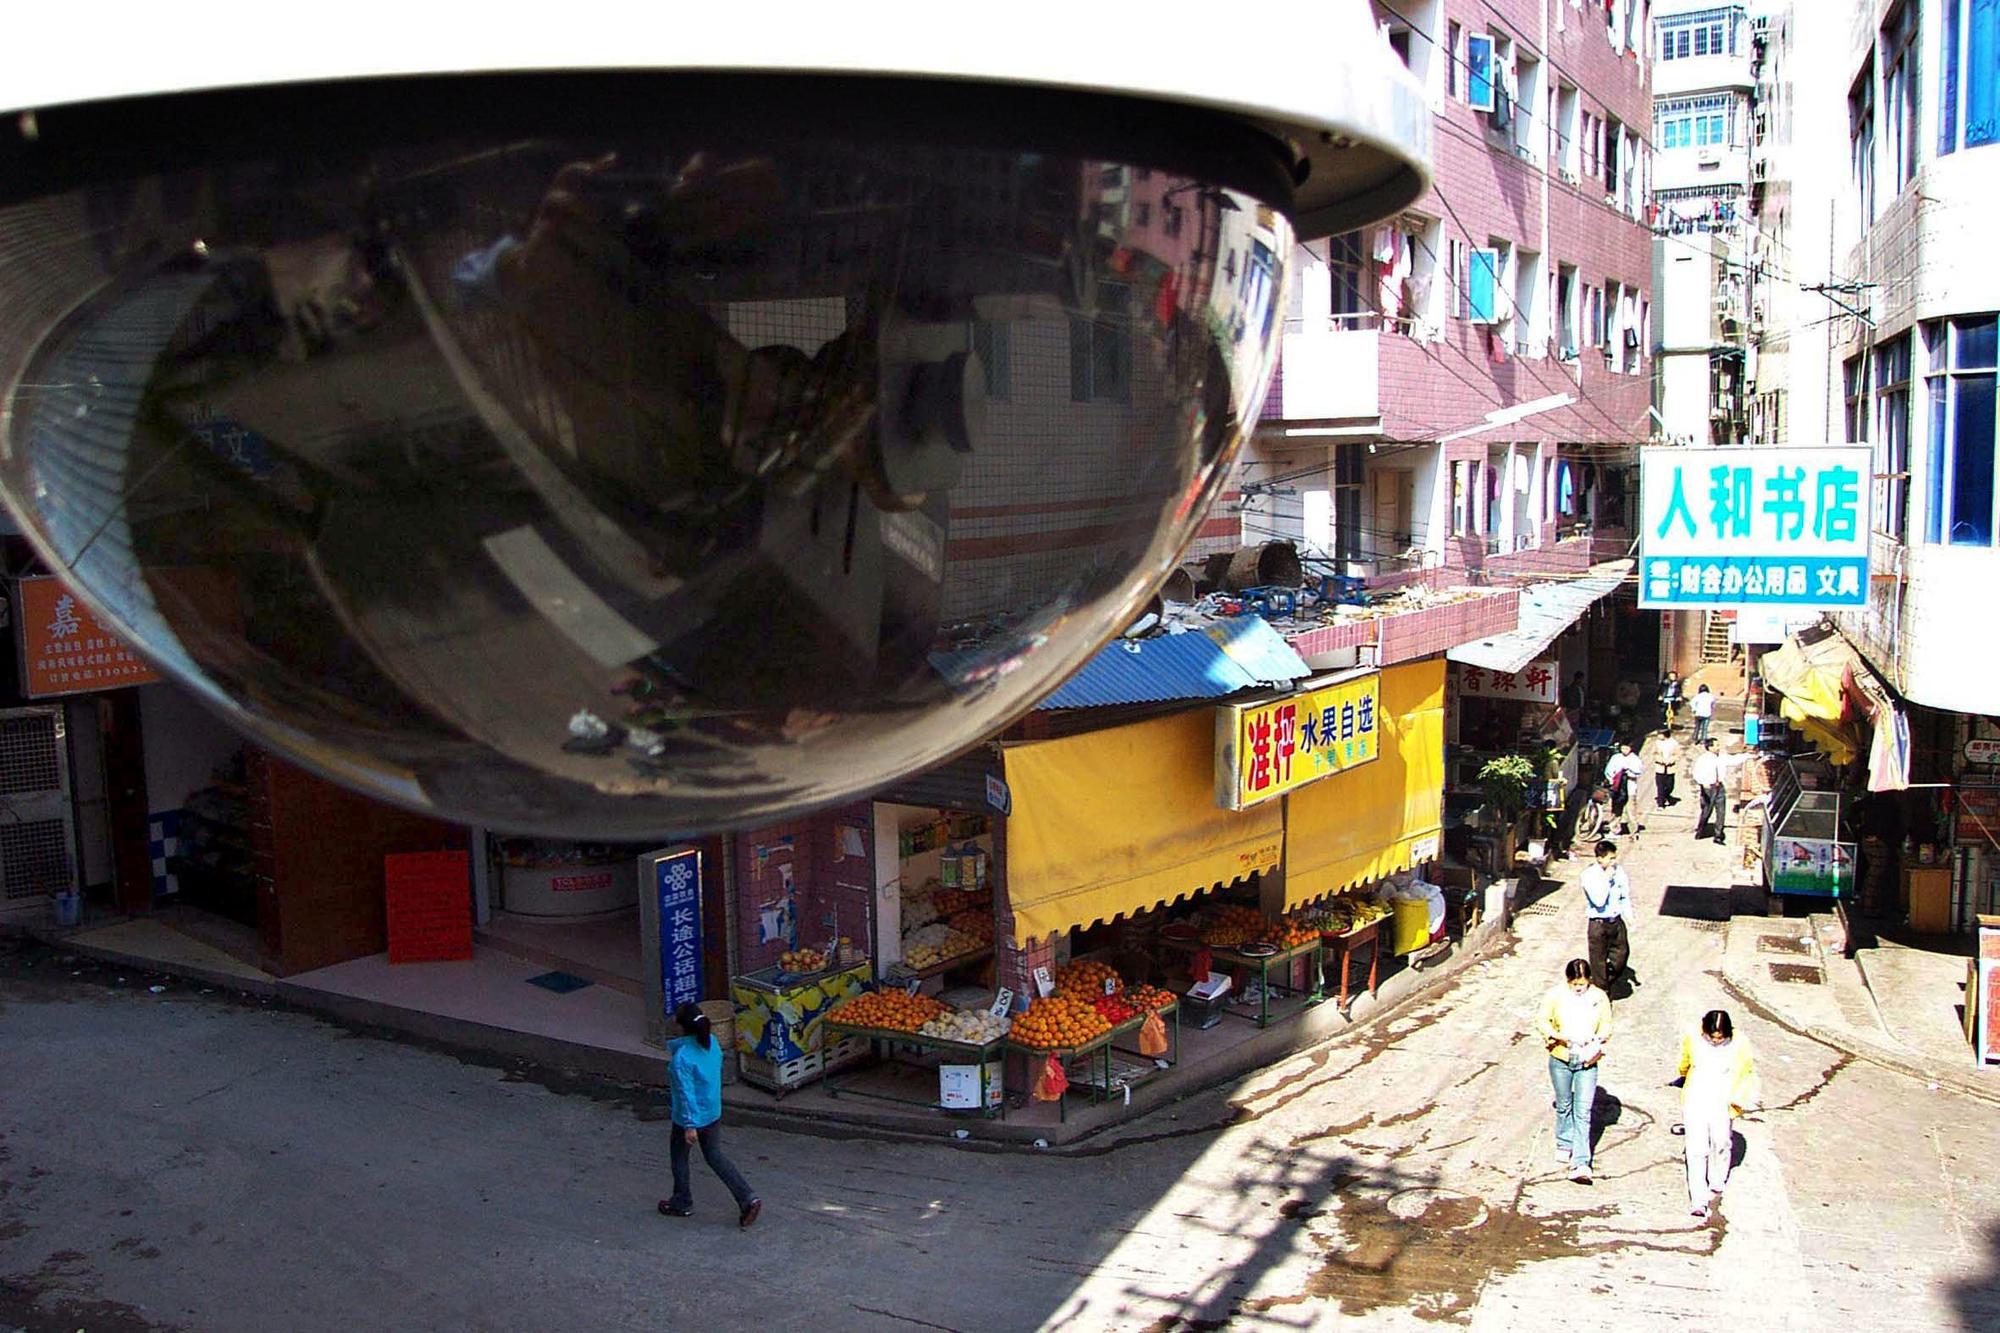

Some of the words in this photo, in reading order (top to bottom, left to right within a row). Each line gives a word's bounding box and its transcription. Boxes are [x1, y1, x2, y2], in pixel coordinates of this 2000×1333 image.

[1657, 464, 1859, 543] 人和书店
[1816, 565, 1861, 598] 文具
[1300, 694, 1374, 755] 水果自选
[670, 907, 698, 1005] 长途公话超市
